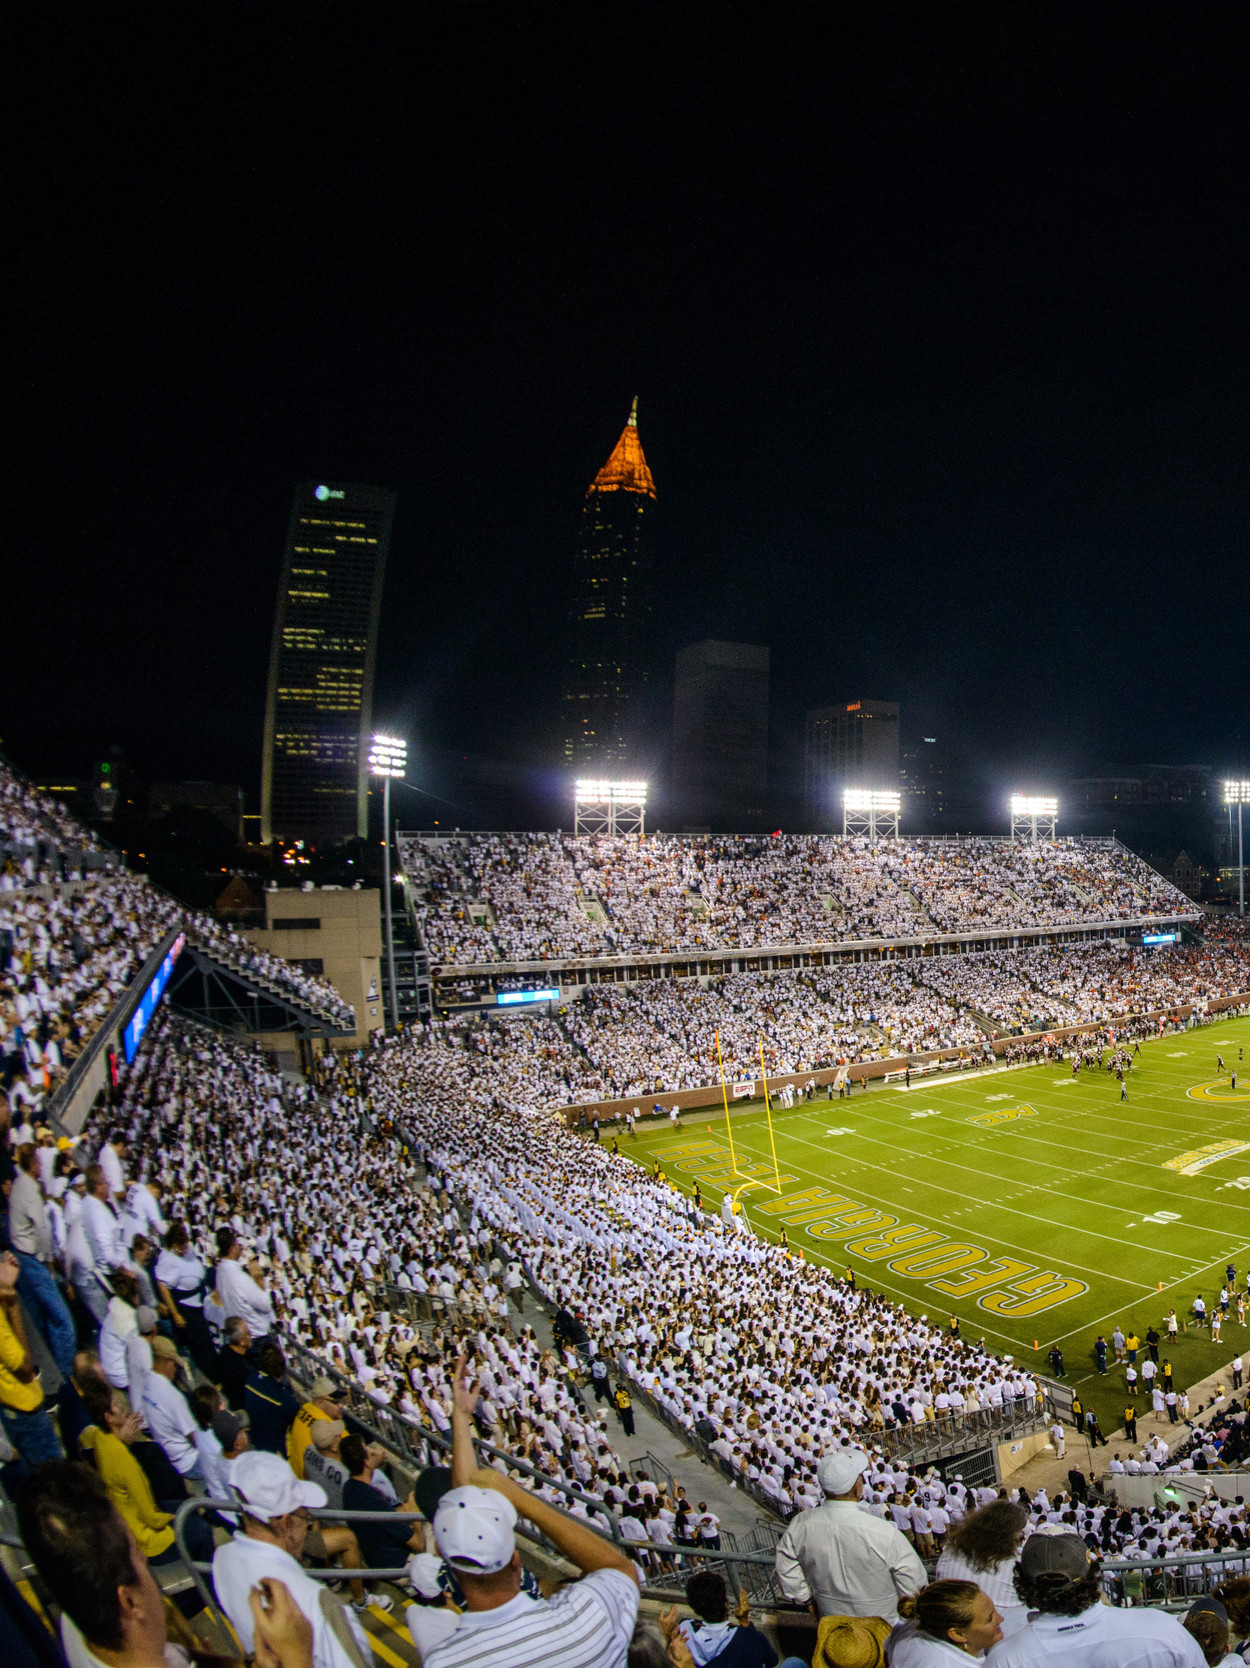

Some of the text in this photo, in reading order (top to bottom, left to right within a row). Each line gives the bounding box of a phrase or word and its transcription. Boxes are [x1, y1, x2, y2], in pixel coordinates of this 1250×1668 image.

[735, 1084, 754, 1093] ESPN
[826, 1127, 857, 1136] 10
[1142, 1210, 1182, 1225] 10
[647, 1140, 1090, 1318] GEORGIA TECH
